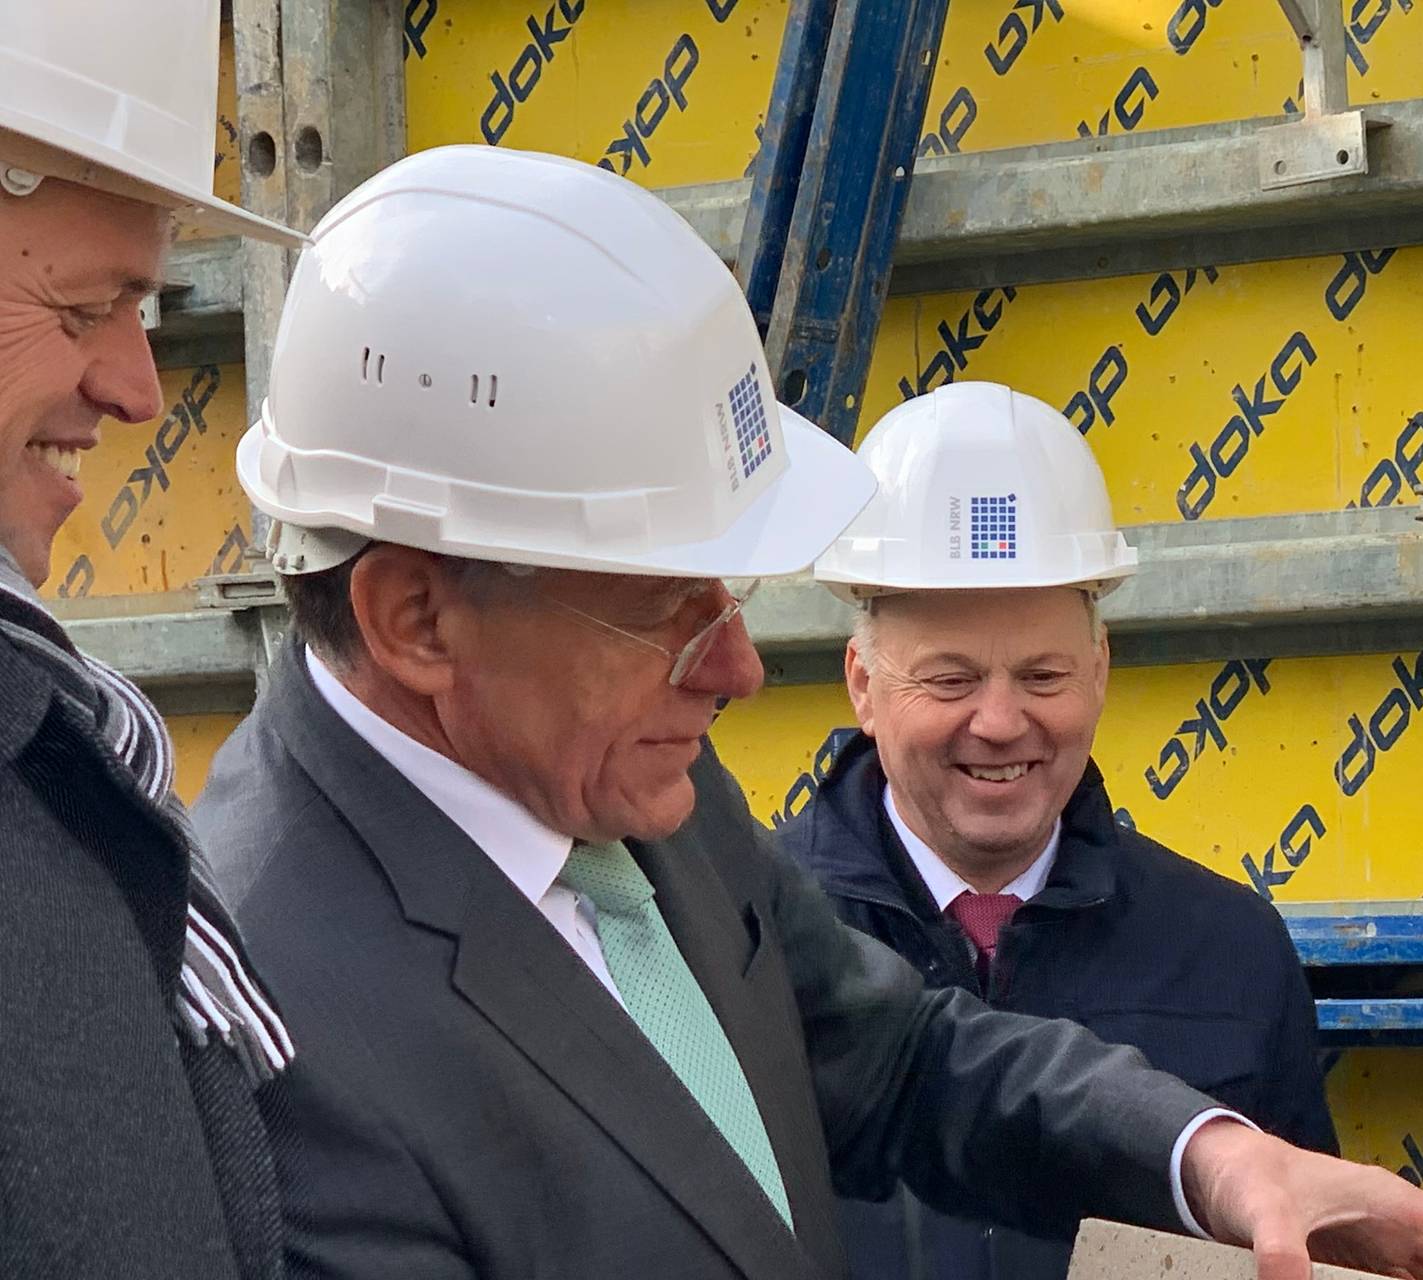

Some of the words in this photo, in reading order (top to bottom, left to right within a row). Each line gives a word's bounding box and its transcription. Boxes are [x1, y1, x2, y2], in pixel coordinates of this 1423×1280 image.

[597, 32, 699, 178] dok
[102, 364, 221, 550] doka
[1176, 331, 1318, 521] doka
[949, 495, 961, 531] NRW
[949, 535, 961, 560] BLB
